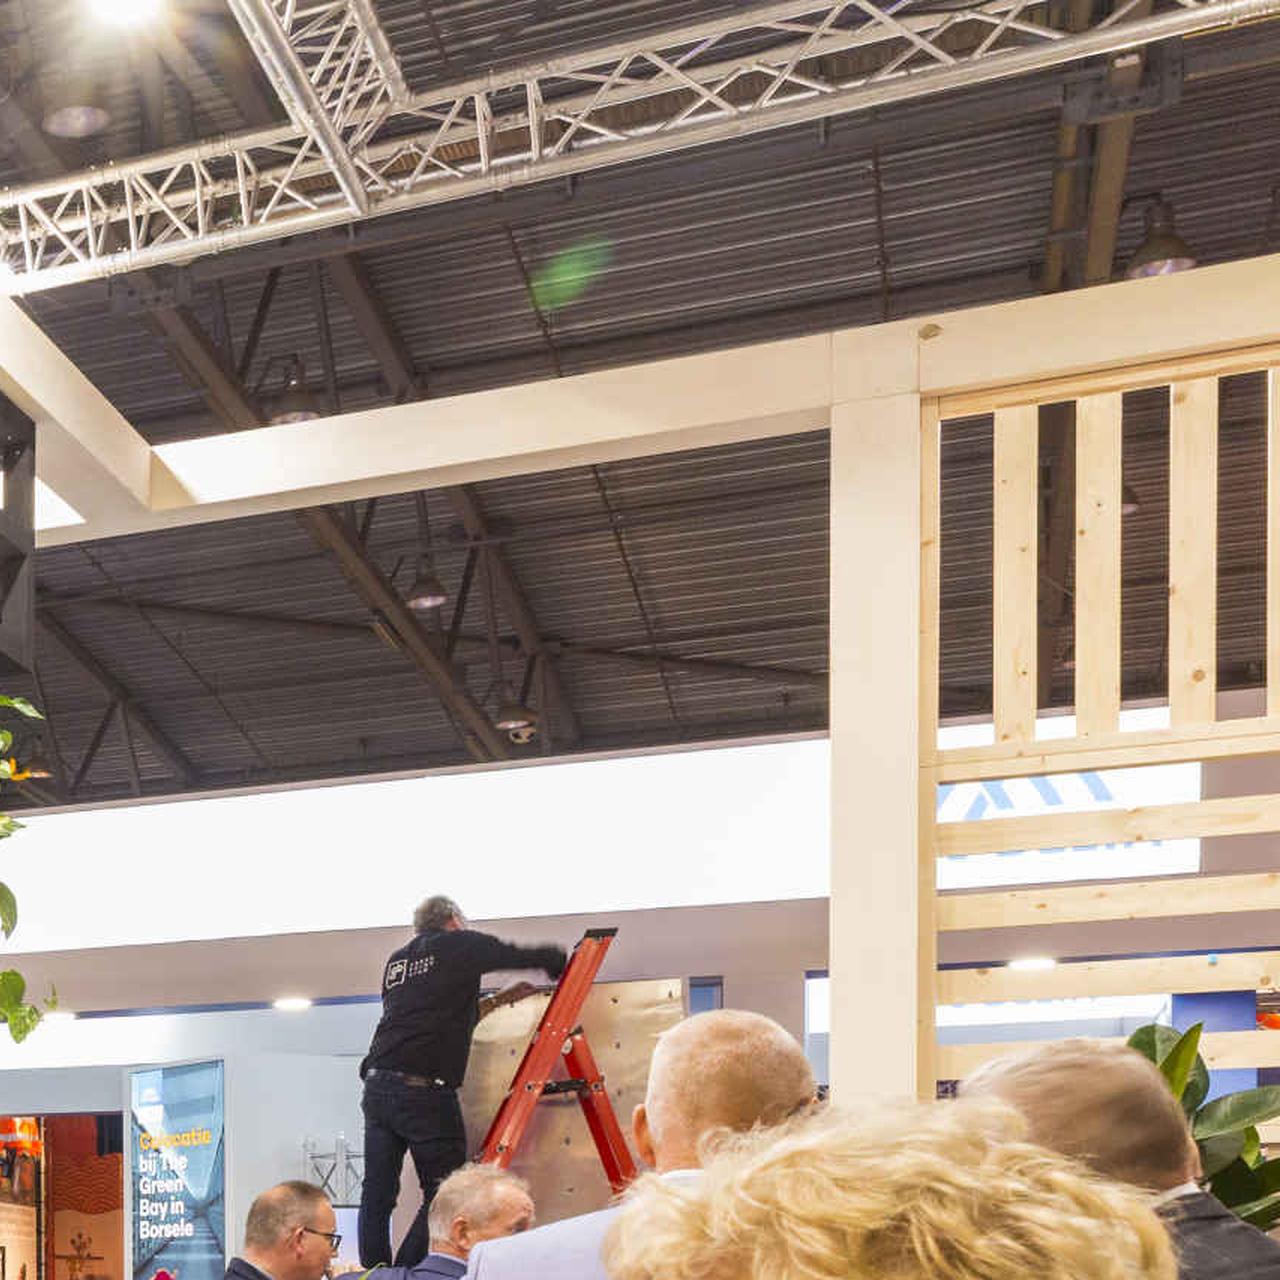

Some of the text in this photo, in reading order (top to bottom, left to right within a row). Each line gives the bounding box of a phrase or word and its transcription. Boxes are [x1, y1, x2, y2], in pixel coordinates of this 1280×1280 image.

[139, 1151, 188, 1176] bij The
[139, 1176, 184, 1195] Green
[139, 1195, 185, 1220] Bay in
[139, 1217, 194, 1240] Borsele
